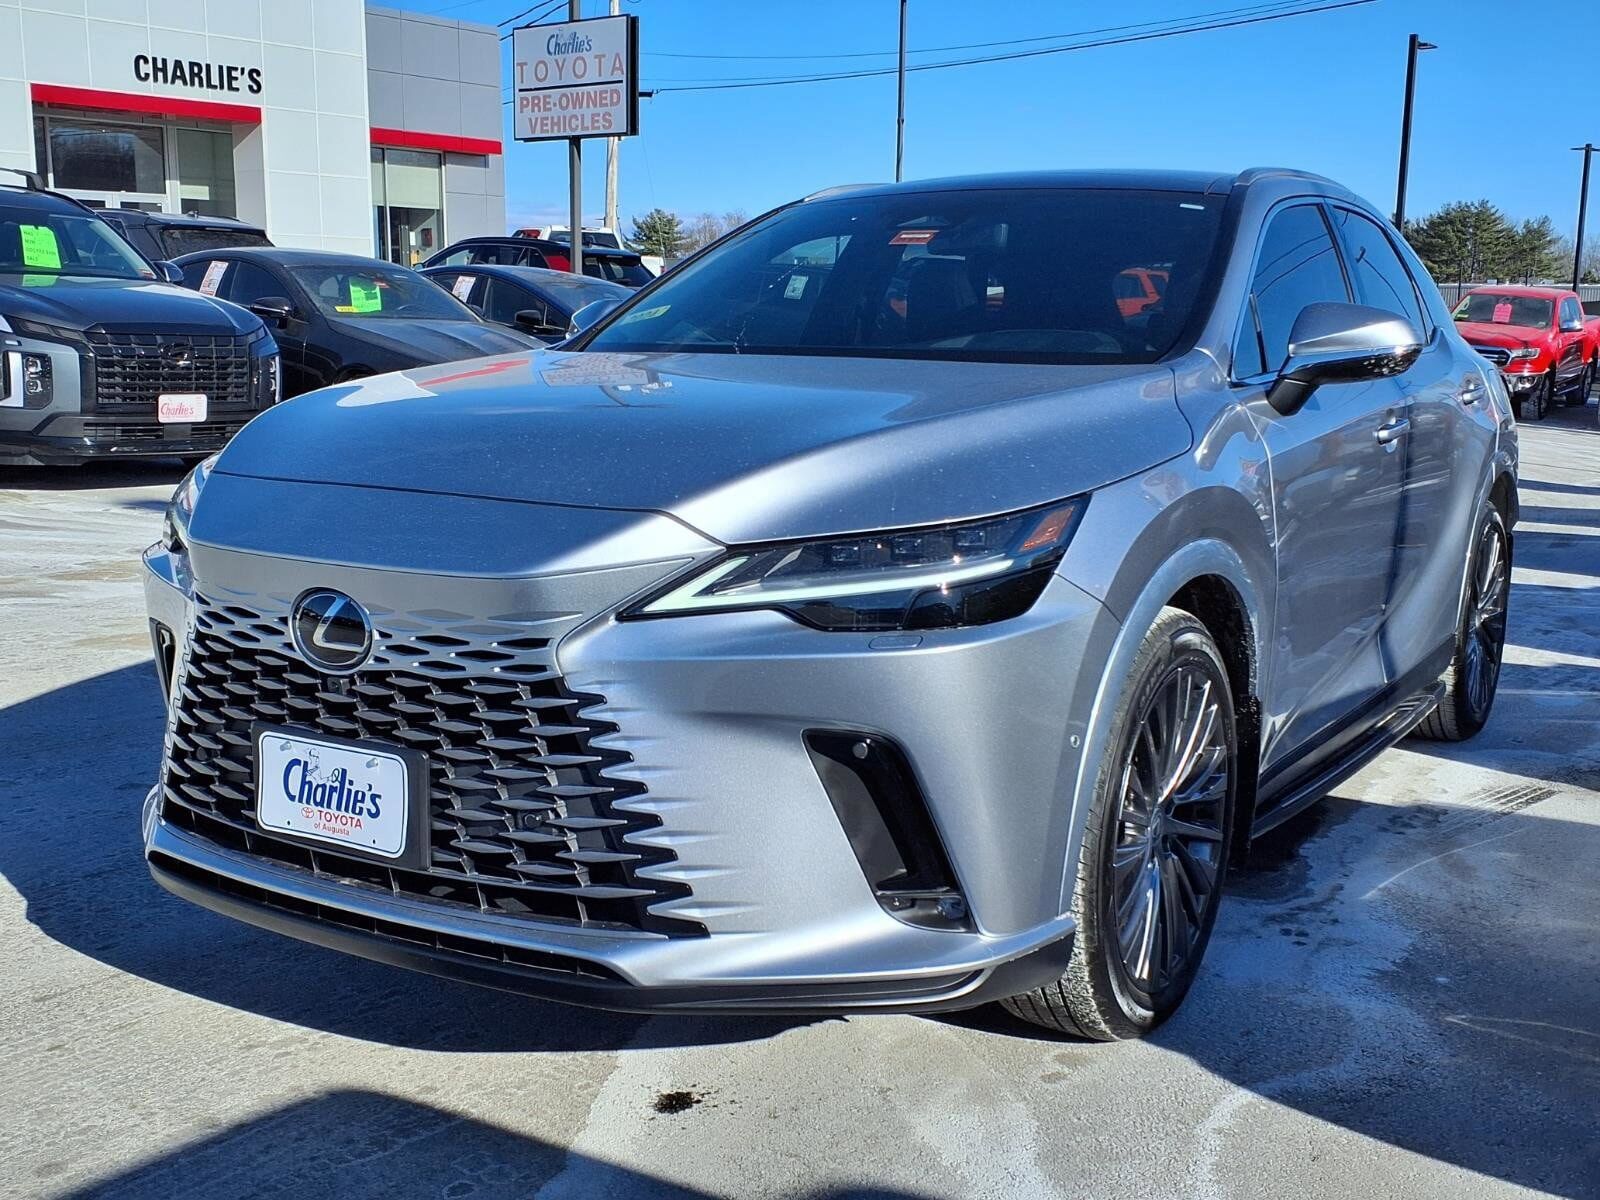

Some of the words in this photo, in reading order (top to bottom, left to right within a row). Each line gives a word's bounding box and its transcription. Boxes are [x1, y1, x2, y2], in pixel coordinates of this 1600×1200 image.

[547, 31, 592, 56] Charlie's
[134, 54, 262, 94] CHARLIE'S
[516, 52, 624, 84] TOYOTA
[519, 88, 621, 114] PRE-OWNED
[528, 111, 613, 134] VEHICLES
[283, 757, 382, 819] Charlie's
[317, 809, 363, 830] TOYOTA
[322, 823, 350, 836] Augusta
